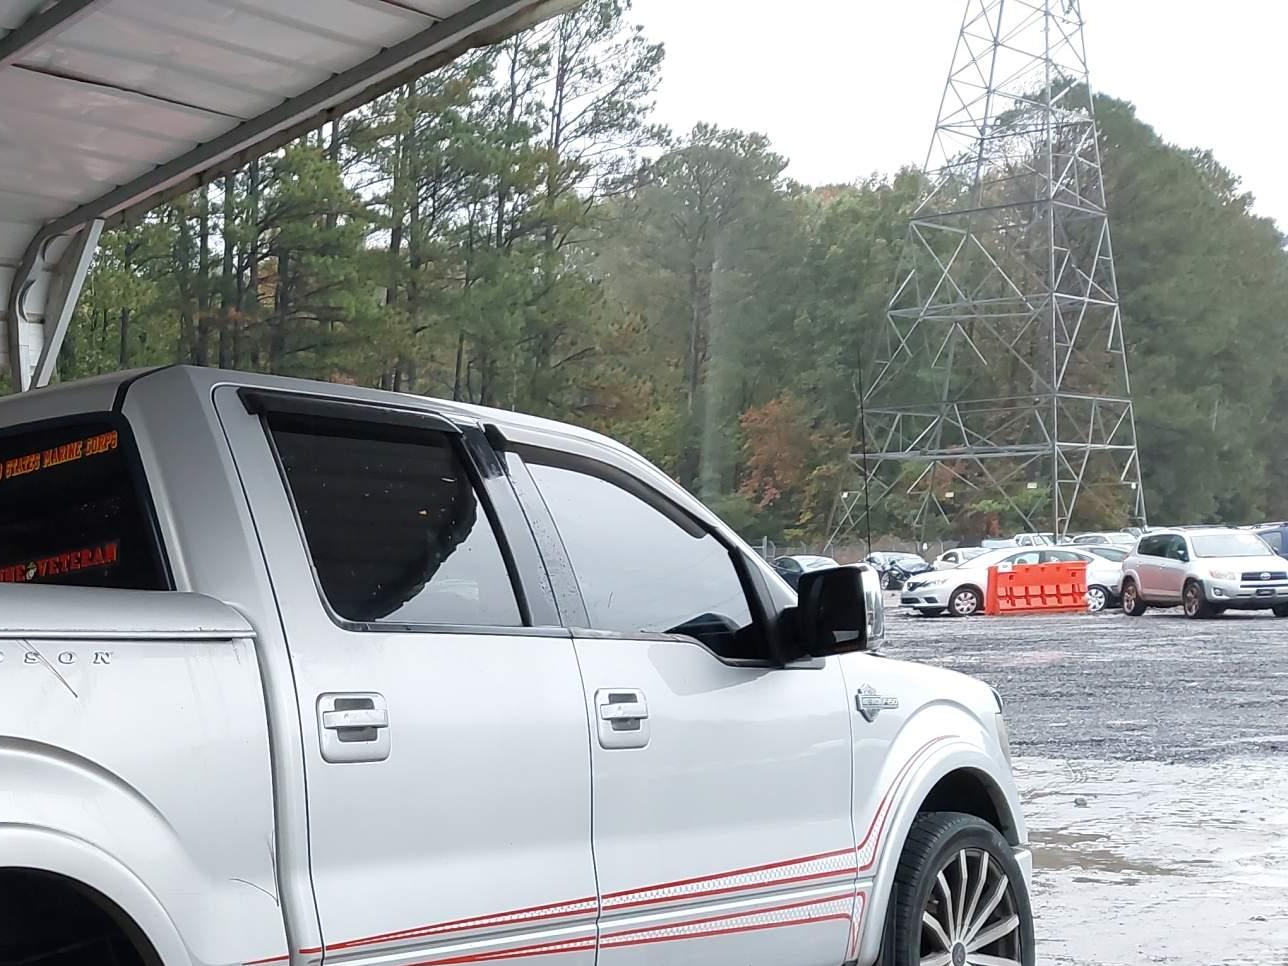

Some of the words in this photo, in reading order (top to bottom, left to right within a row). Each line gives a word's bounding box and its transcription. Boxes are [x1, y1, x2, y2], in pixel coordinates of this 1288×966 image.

[6, 452, 41, 478] STATES
[42, 440, 82, 467] MARINE
[85, 430, 117, 456] CORPS
[37, 543, 118, 577] VETERAN
